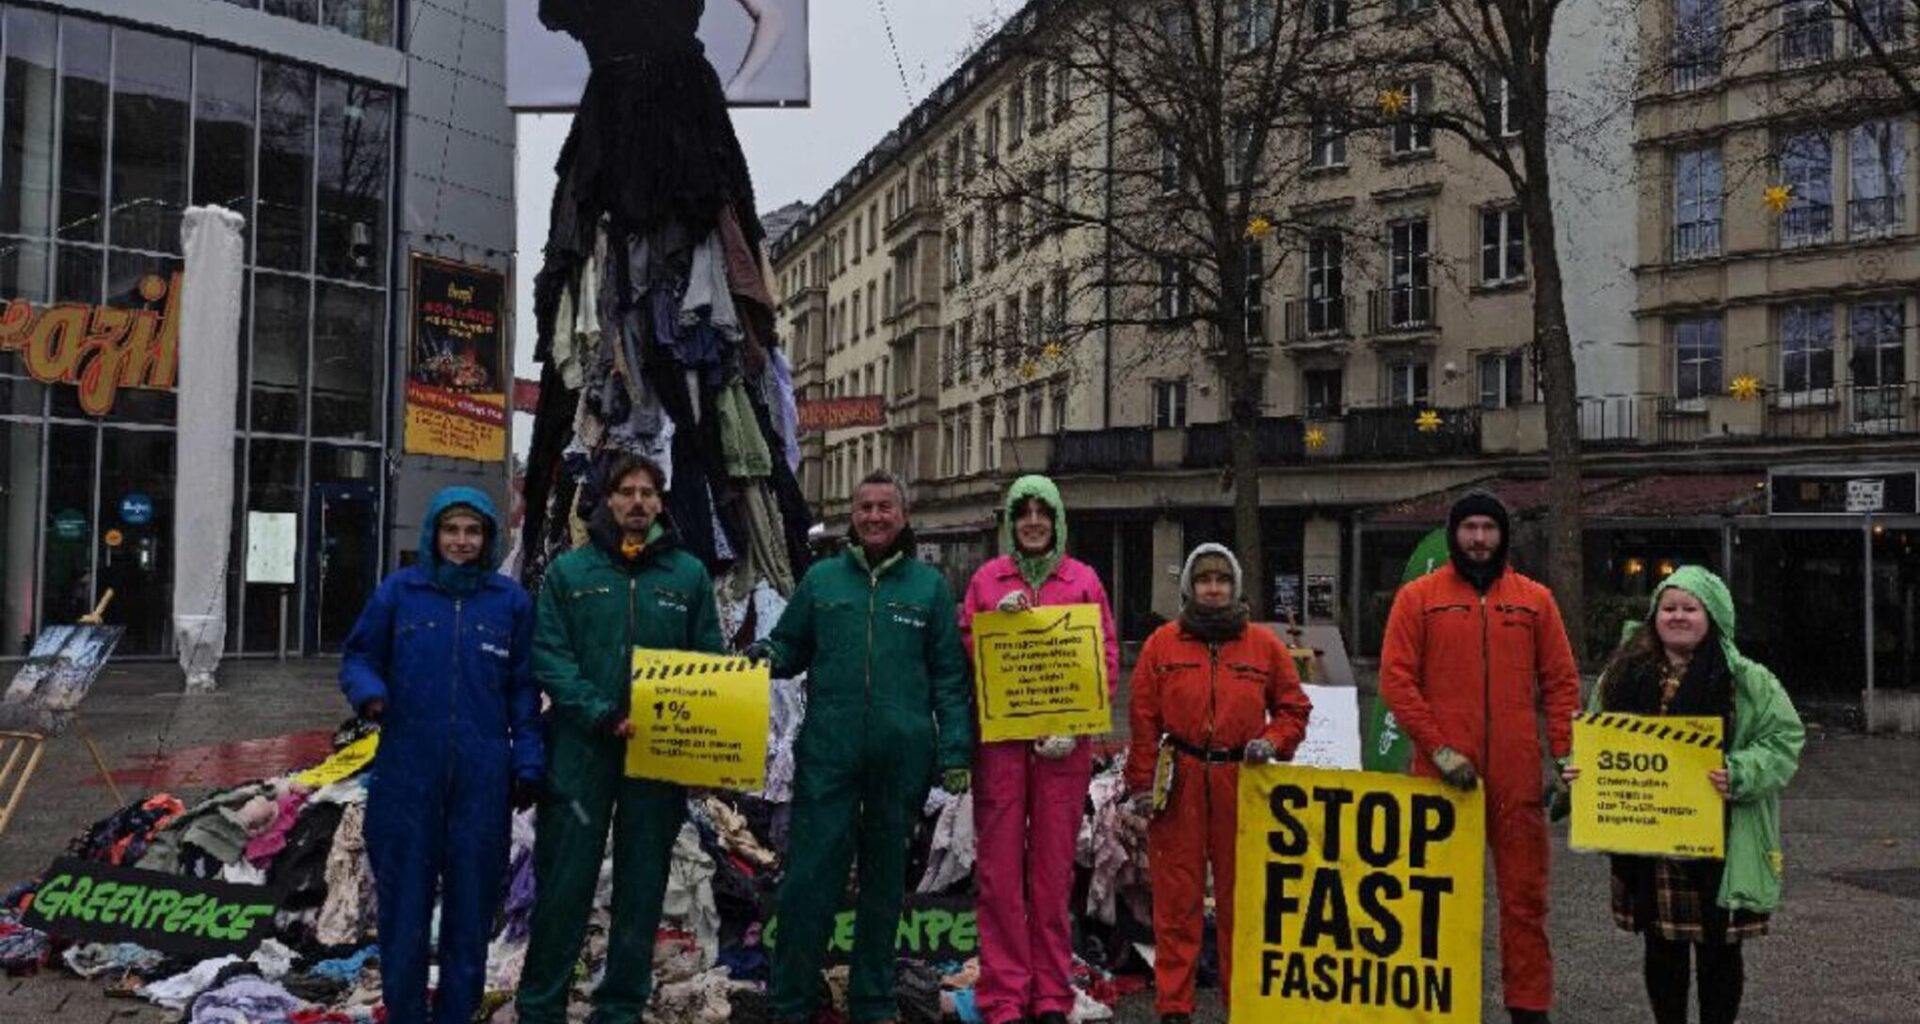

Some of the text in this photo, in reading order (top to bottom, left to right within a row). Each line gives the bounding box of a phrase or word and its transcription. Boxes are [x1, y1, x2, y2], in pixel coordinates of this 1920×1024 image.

[1597, 750, 1669, 773] 3500
[1267, 784, 1457, 868] STOP
[33, 873, 275, 940] GREENPEACE
[1263, 861, 1454, 960] FAST
[1261, 950, 1452, 1014] FASHION
